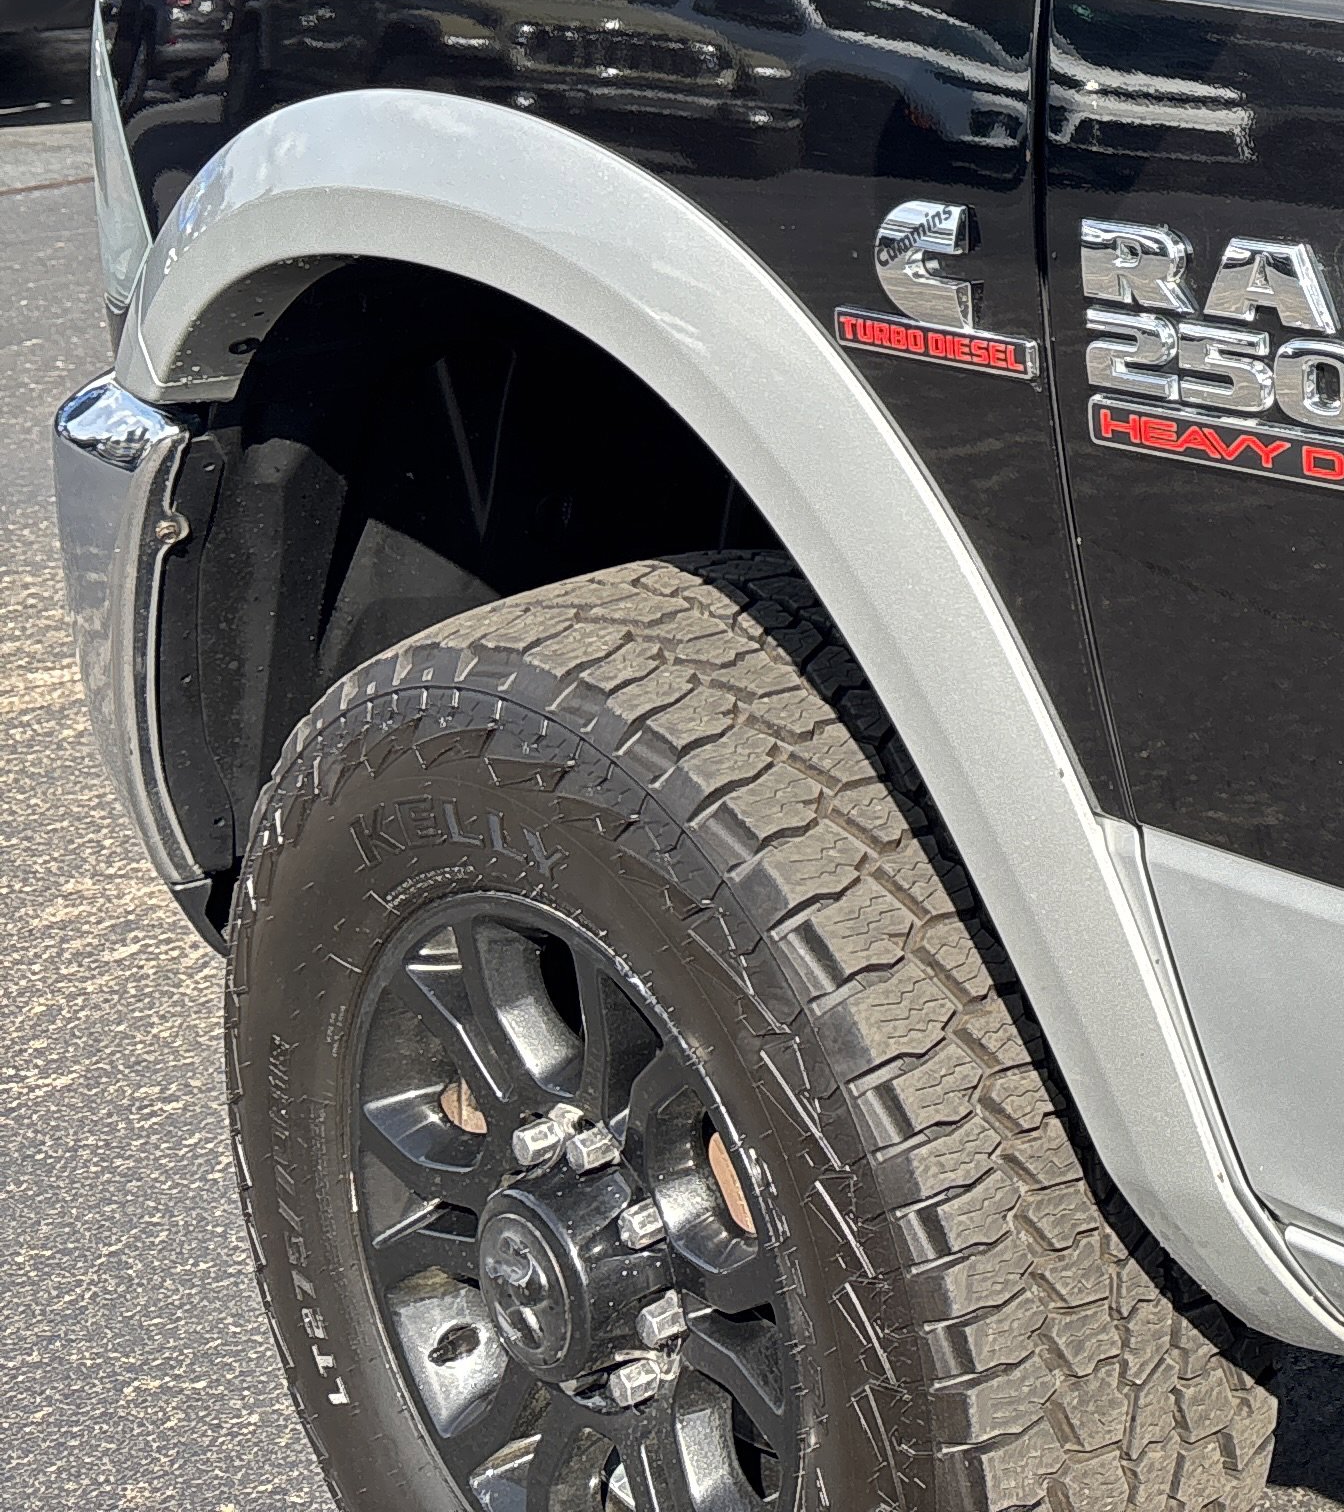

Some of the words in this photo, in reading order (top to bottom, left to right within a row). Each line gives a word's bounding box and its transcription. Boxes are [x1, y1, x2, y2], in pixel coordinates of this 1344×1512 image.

[876, 204, 953, 267] Cummins
[839, 314, 925, 354] TURBO
[927, 331, 1025, 372] DIESEL
[1099, 408, 1292, 469] HEAVY
[350, 794, 569, 878] KELLY
